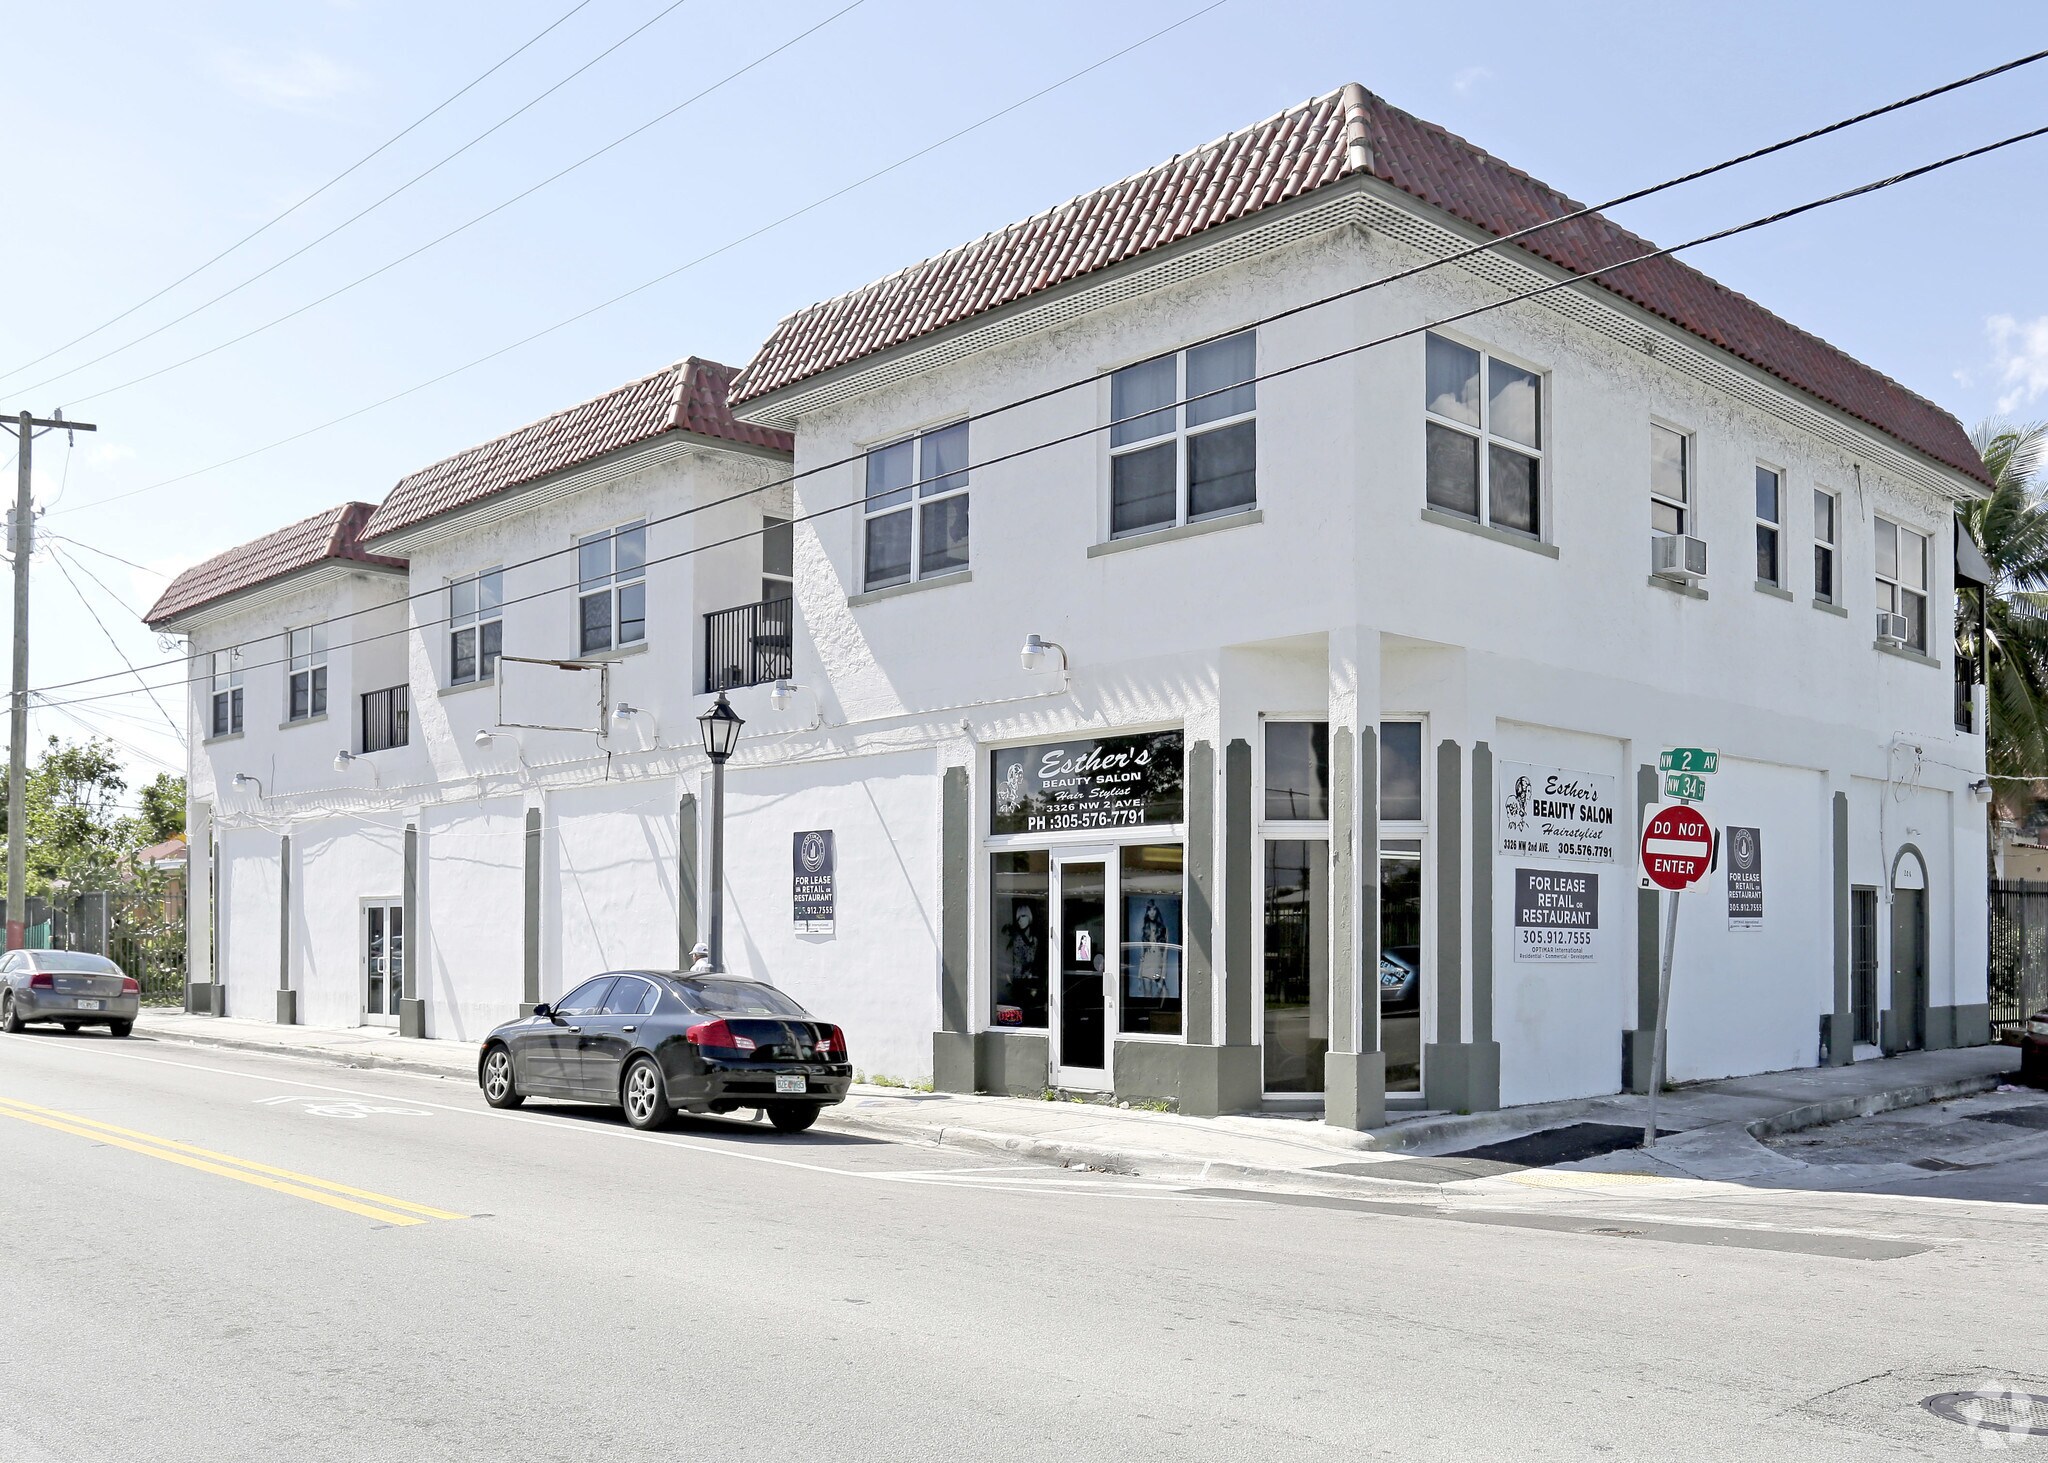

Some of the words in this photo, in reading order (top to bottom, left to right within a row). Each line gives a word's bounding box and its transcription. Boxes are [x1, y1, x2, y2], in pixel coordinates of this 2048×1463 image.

[1038, 746, 1152, 778] Esther's
[1660, 755, 1673, 767] NW
[1682, 752, 1692, 770] 2
[1703, 756, 1716, 769] AV
[1042, 777, 1091, 788] BEAUTY
[1096, 772, 1141, 783] SALON
[1667, 778, 1680, 792] NW
[1683, 777, 1697, 797] 34
[1699, 784, 1705, 798] ST
[1054, 790, 1084, 801] Hair
[1089, 787, 1131, 800] Stylist
[1545, 775, 1599, 802] Esther's
[1046, 804, 1075, 813] 3326
[1080, 802, 1100, 810] NW
[1103, 801, 1111, 809] 2
[1115, 799, 1145, 808] AVE.
[1533, 799, 1575, 820] BEAUTY
[1580, 804, 1613, 825] SALON
[1028, 816, 1046, 831] PH
[1654, 821, 1671, 835] DO
[1678, 822, 1704, 837] NOT
[1541, 823, 1603, 841] Hairstylist
[1503, 839, 1517, 850] 3326
[1518, 840, 1527, 851] NW
[1528, 841, 1537, 852] 2nd
[1538, 842, 1549, 853] AVE.
[1558, 843, 1612, 858] 305.576.7791
[1654, 858, 1695, 875] ENTER
[796, 877, 809, 885] FOR
[810, 876, 831, 885] LEASE
[1529, 876, 1551, 891] FOR
[1554, 878, 1586, 892] LEASE
[1729, 872, 1741, 881] FOR
[1742, 873, 1760, 882] LEASE
[802, 885, 825, 893] RETAIL
[1735, 882, 1754, 890] RETAIL
[1538, 893, 1574, 908] RETAIL
[1729, 890, 1761, 899] RESTAURANT
[1522, 909, 1591, 925] RESTAURANT
[1523, 930, 1591, 944] 305.912.7555
